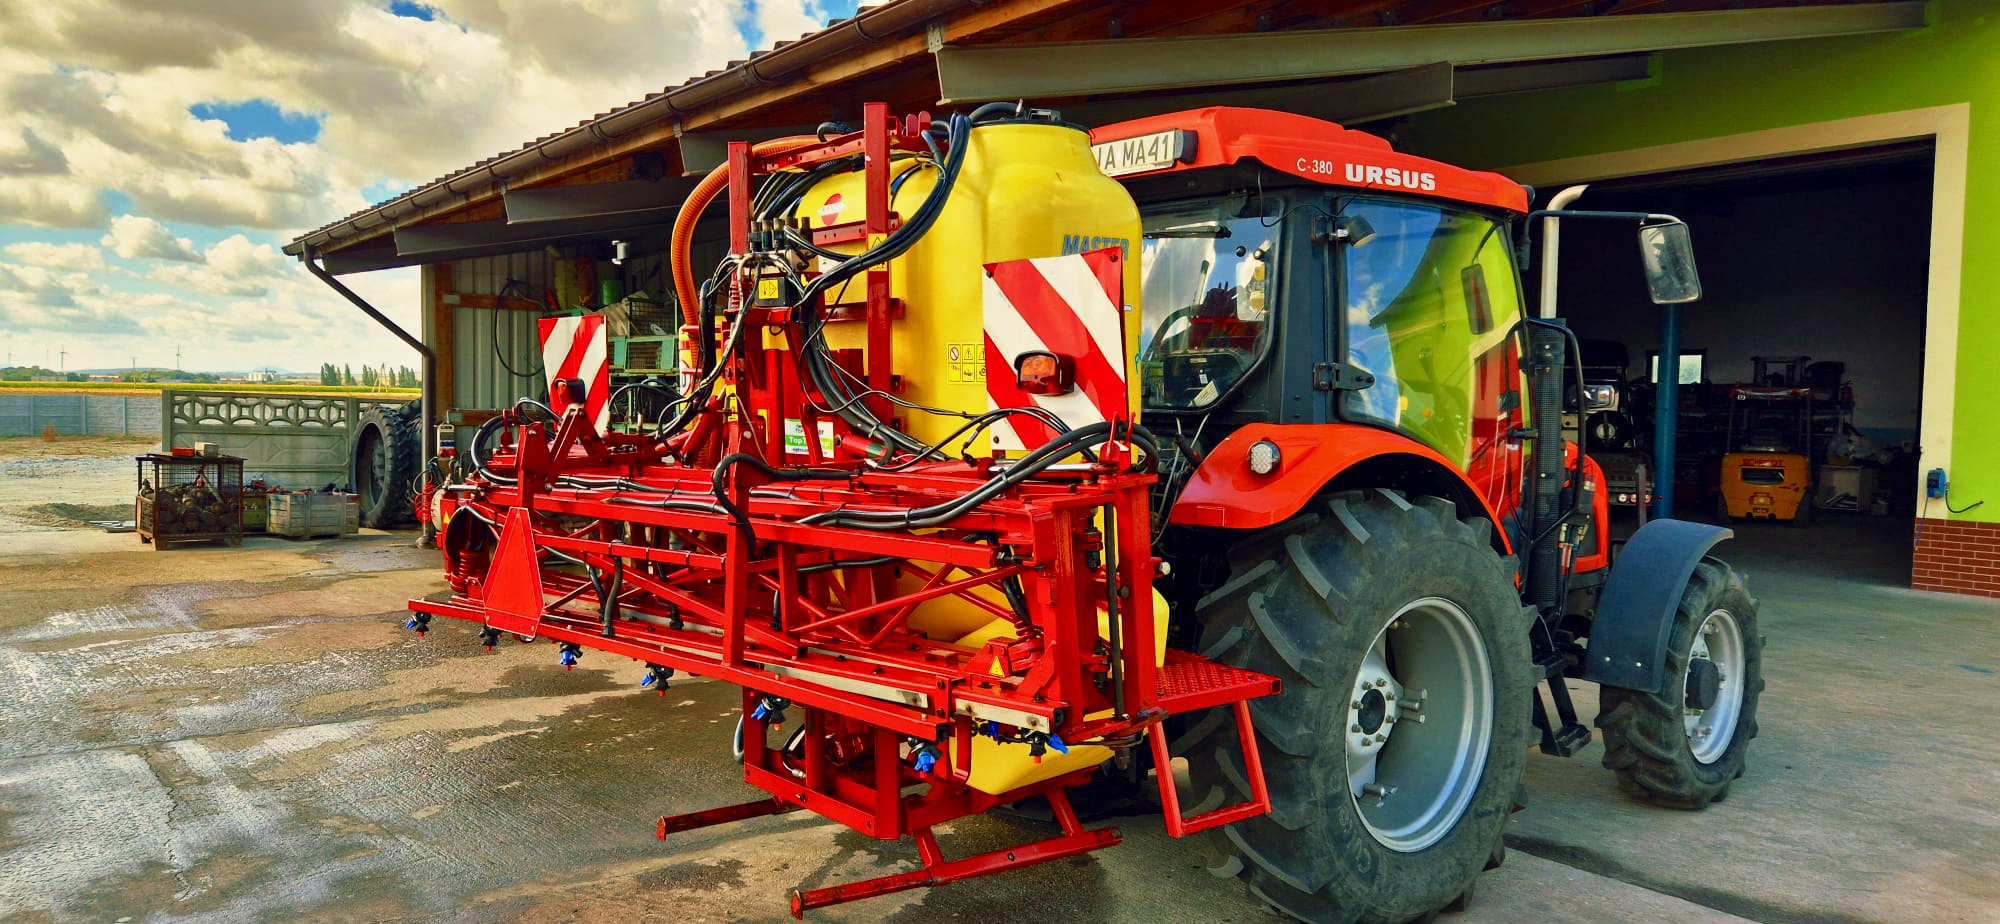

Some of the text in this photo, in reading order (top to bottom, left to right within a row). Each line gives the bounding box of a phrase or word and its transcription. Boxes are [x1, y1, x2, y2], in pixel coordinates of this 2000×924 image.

[1122, 133, 1170, 167] MA41
[1296, 156, 1436, 192] C-380 URSUS
